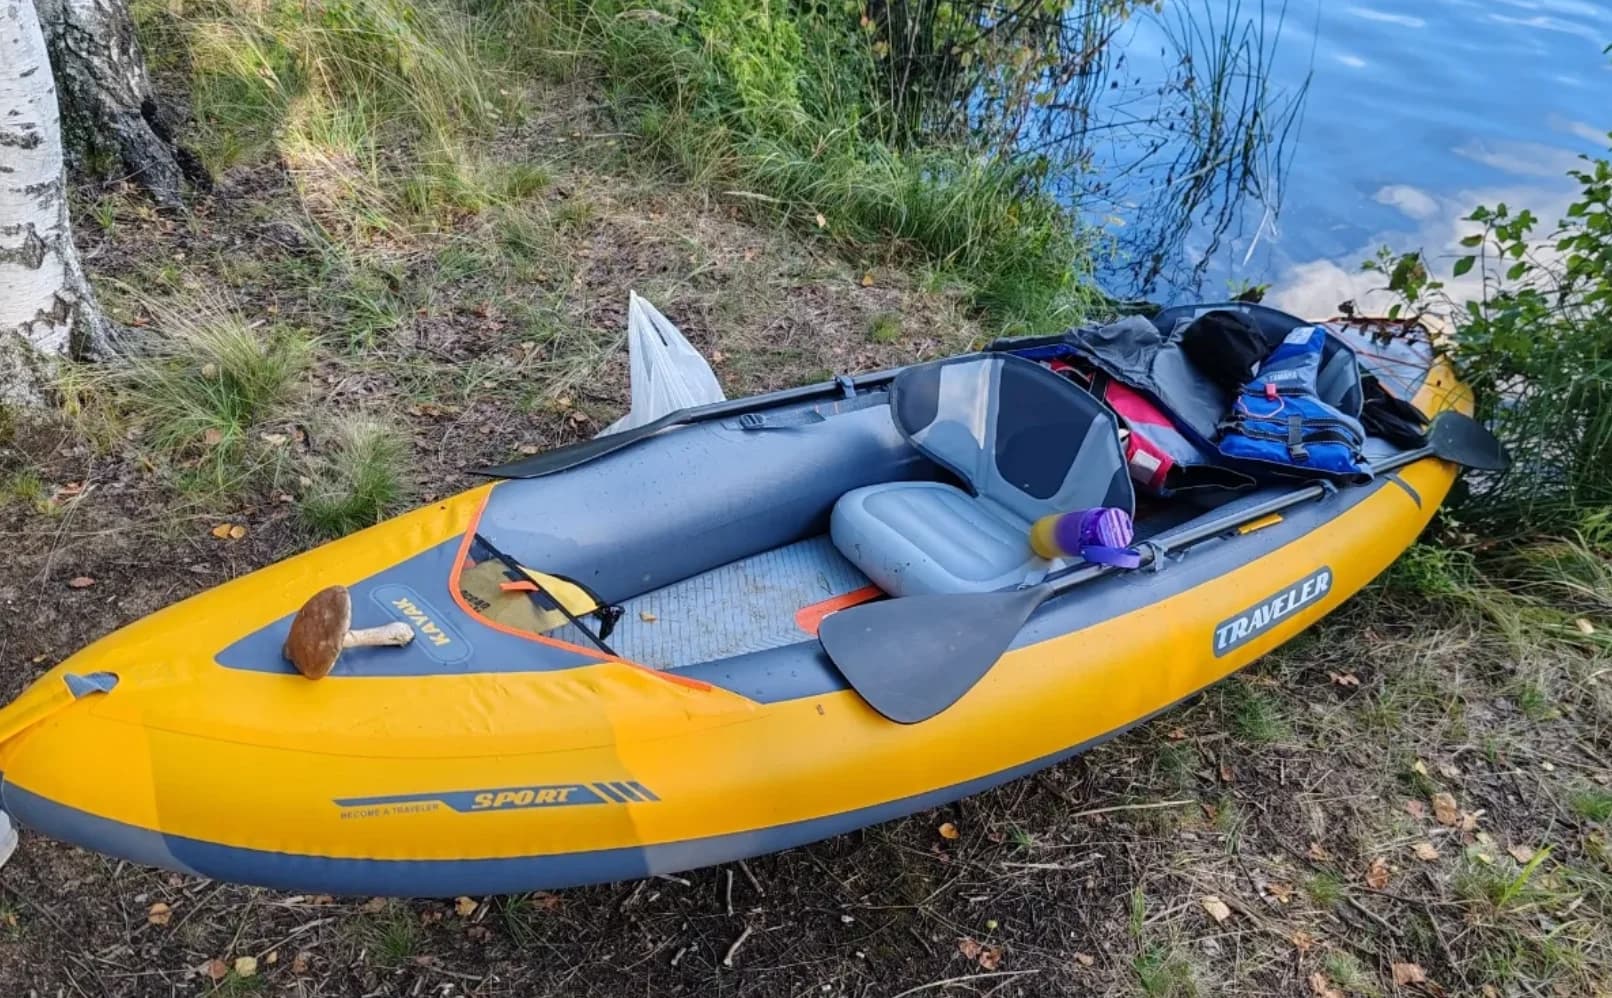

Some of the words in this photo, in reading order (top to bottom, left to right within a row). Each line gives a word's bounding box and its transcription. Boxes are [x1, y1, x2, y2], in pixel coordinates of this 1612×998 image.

[1216, 571, 1329, 650] TRAVELER
[472, 787, 578, 809] SPORT
[340, 808, 380, 820] BECOME
[393, 803, 439, 815] TRAVELER
